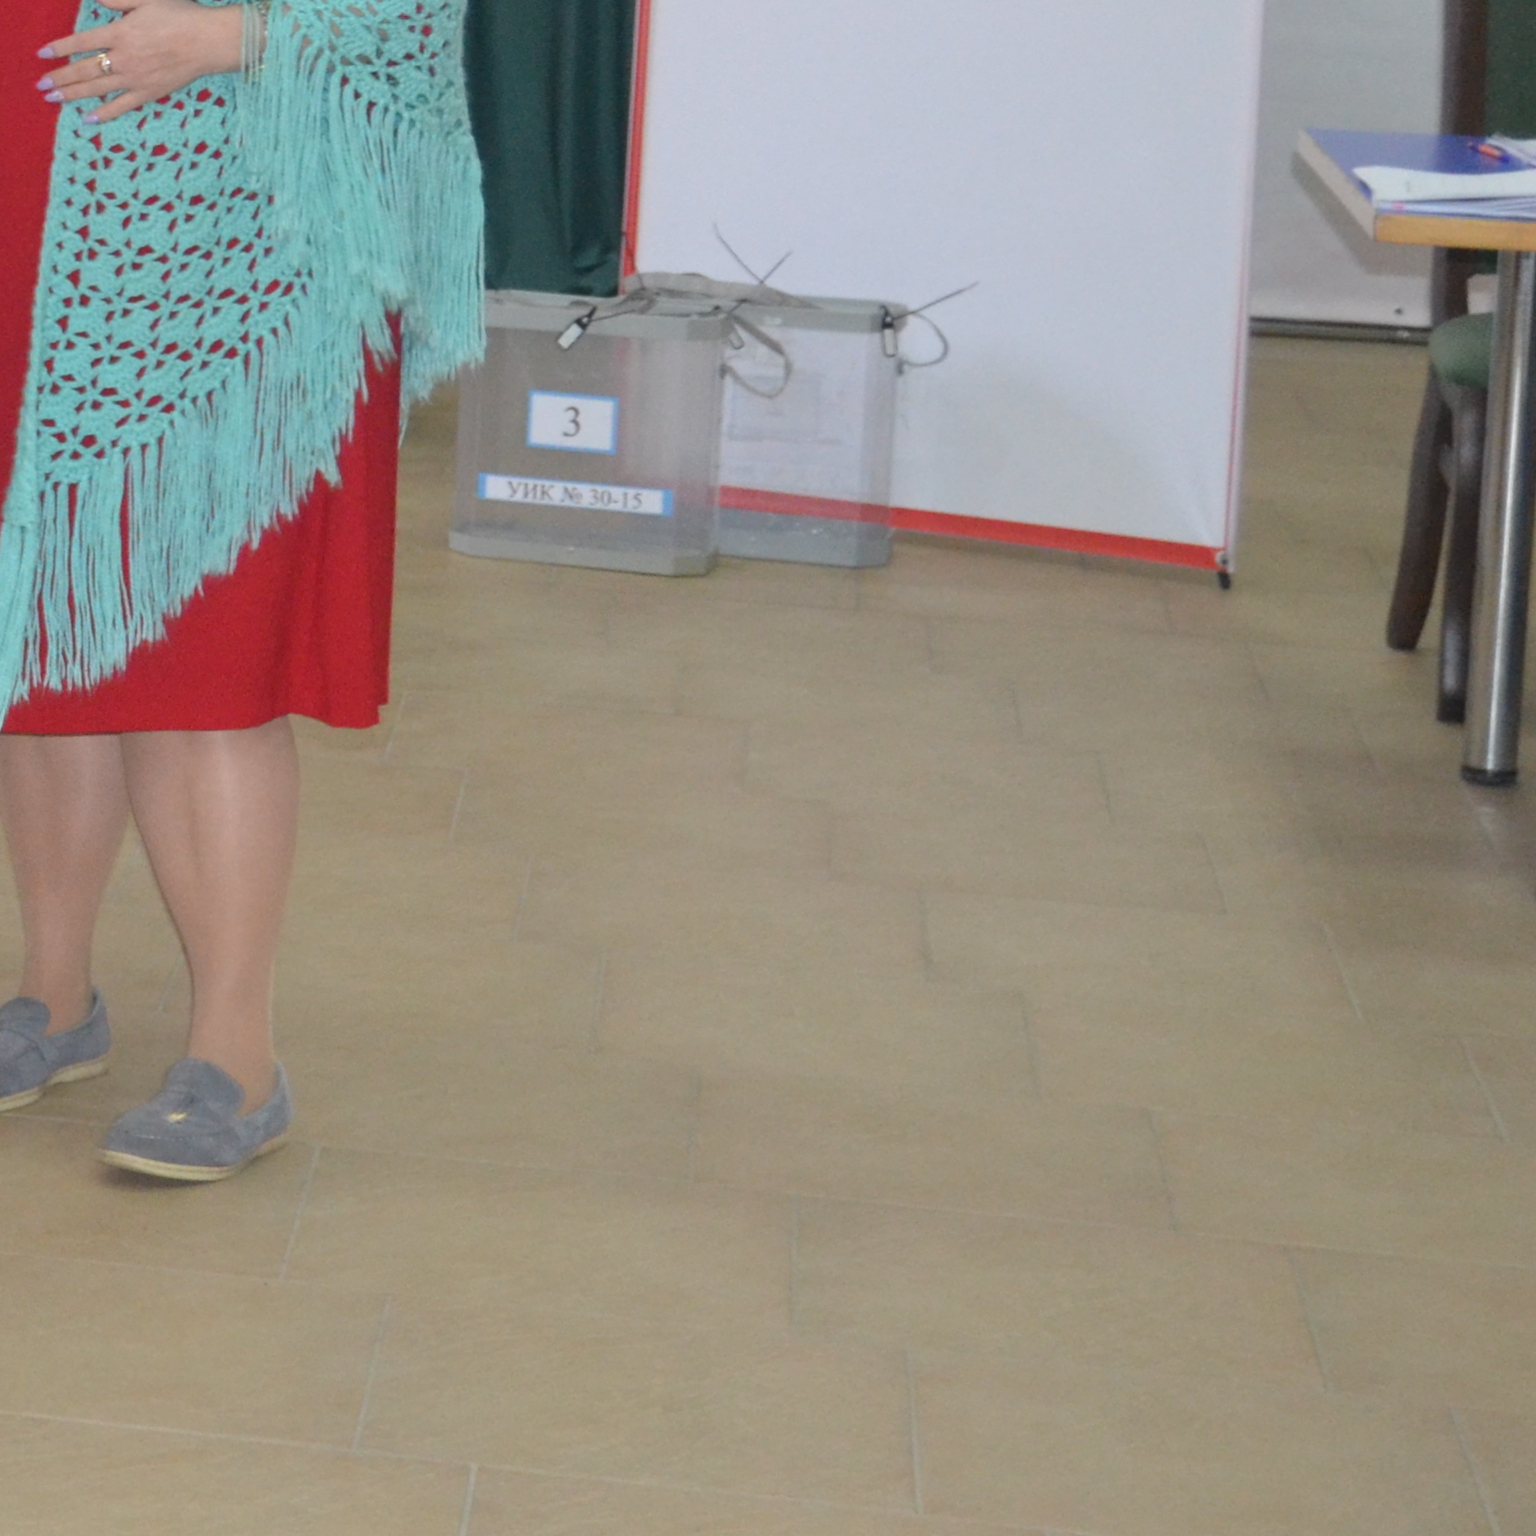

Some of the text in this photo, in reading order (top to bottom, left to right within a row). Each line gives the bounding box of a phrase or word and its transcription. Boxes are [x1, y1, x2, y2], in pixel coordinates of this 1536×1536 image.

[561, 405, 582, 438] 3
[506, 480, 644, 510] УИК № 30-15
